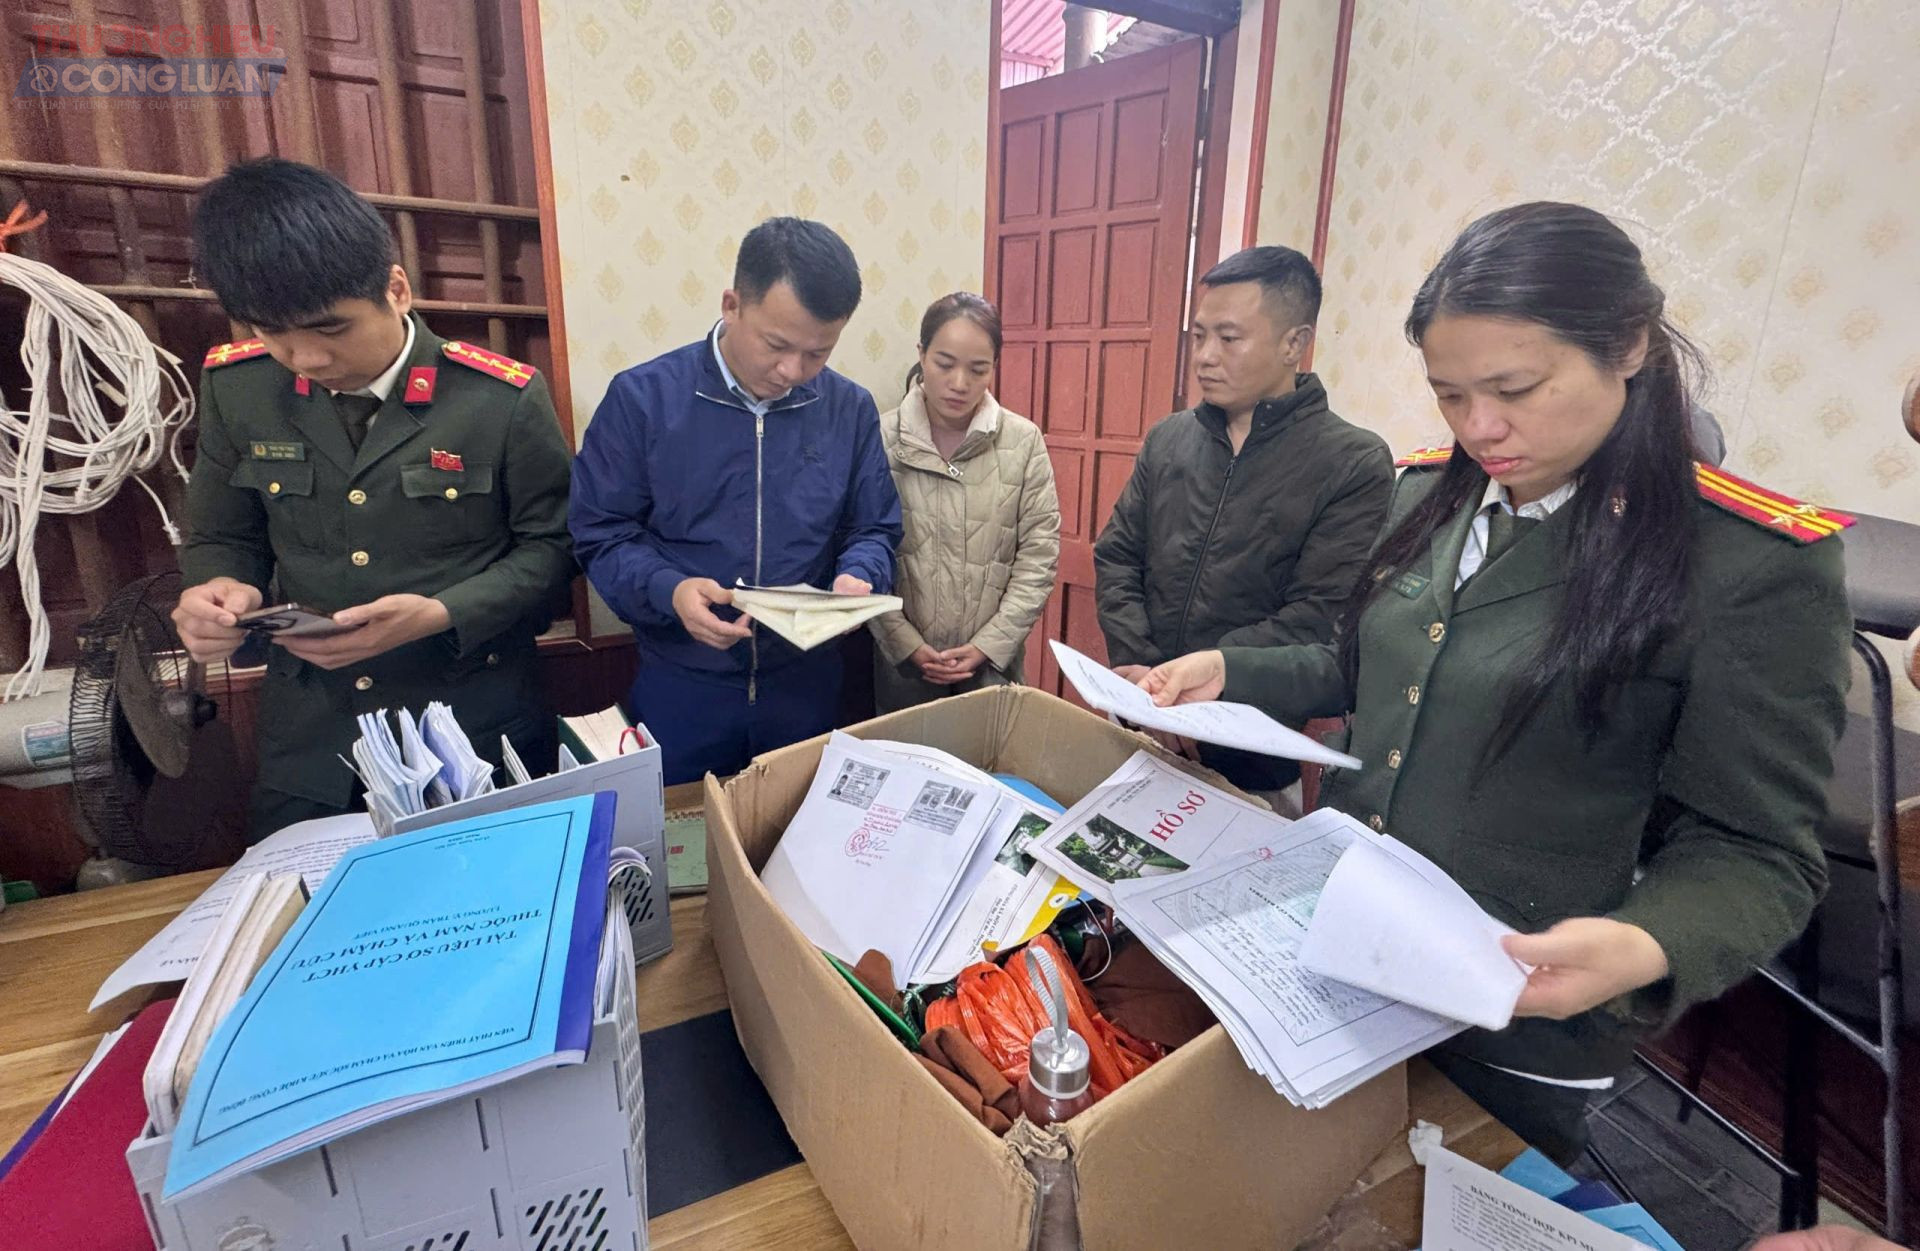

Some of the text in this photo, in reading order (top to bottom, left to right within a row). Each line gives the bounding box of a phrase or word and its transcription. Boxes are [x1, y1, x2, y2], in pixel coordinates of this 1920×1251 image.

[1148, 808, 1184, 842] HỒ
[1177, 789, 1206, 816] SƠ
[433, 921, 476, 938] NAM
